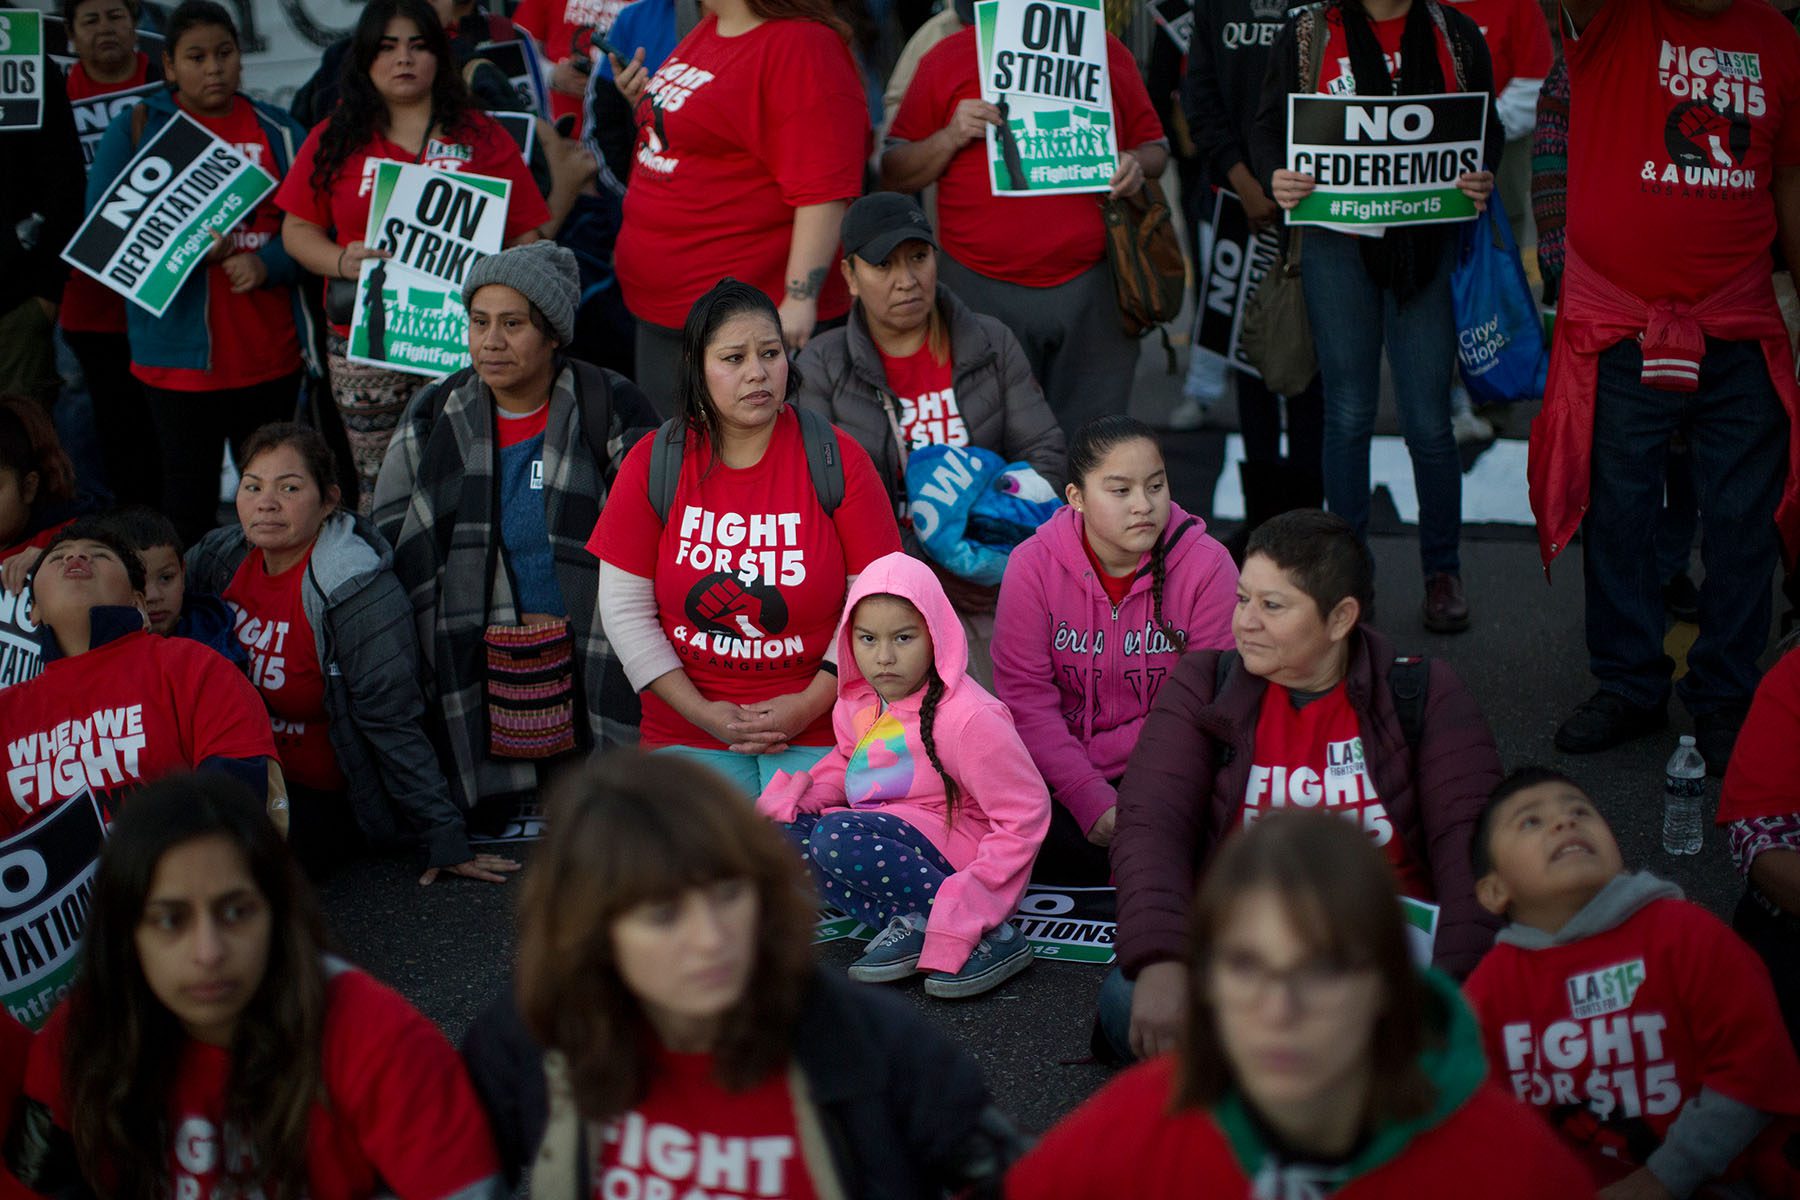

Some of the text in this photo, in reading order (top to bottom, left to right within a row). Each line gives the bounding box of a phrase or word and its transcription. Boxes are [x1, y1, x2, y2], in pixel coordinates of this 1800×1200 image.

[1022, 3, 1085, 56] ON
[1222, 21, 1285, 50] QUE
[995, 51, 1101, 102] STRIKE
[1715, 50, 1759, 78] LA $15
[1658, 71, 1767, 117] FOR $15
[1343, 104, 1435, 142] NO
[100, 155, 174, 231] NO
[1030, 161, 1114, 184] #FightFor15
[1641, 160, 1756, 188] & A UNION
[109, 148, 242, 289] DEPORTATIONS
[416, 178, 488, 241] ON
[1329, 197, 1442, 220] #FightFor15
[378, 217, 487, 285] STRIK
[1207, 238, 1243, 318] NO
[1459, 320, 1490, 350] City
[1464, 333, 1506, 367] Hope
[679, 505, 801, 547] FIGHT
[675, 539, 807, 588] FOR $15
[689, 631, 708, 651] A
[712, 635, 805, 660] UNION
[708, 656, 805, 671] ANGELES
[7, 704, 143, 768] WHEN WE
[1329, 743, 1353, 766] LA
[6, 733, 147, 814] FIGHT
[1569, 975, 1600, 1006] LA
[1585, 1060, 1682, 1122] $15
[602, 1110, 794, 1198] IGHT
[600, 1166, 677, 1200] OR
